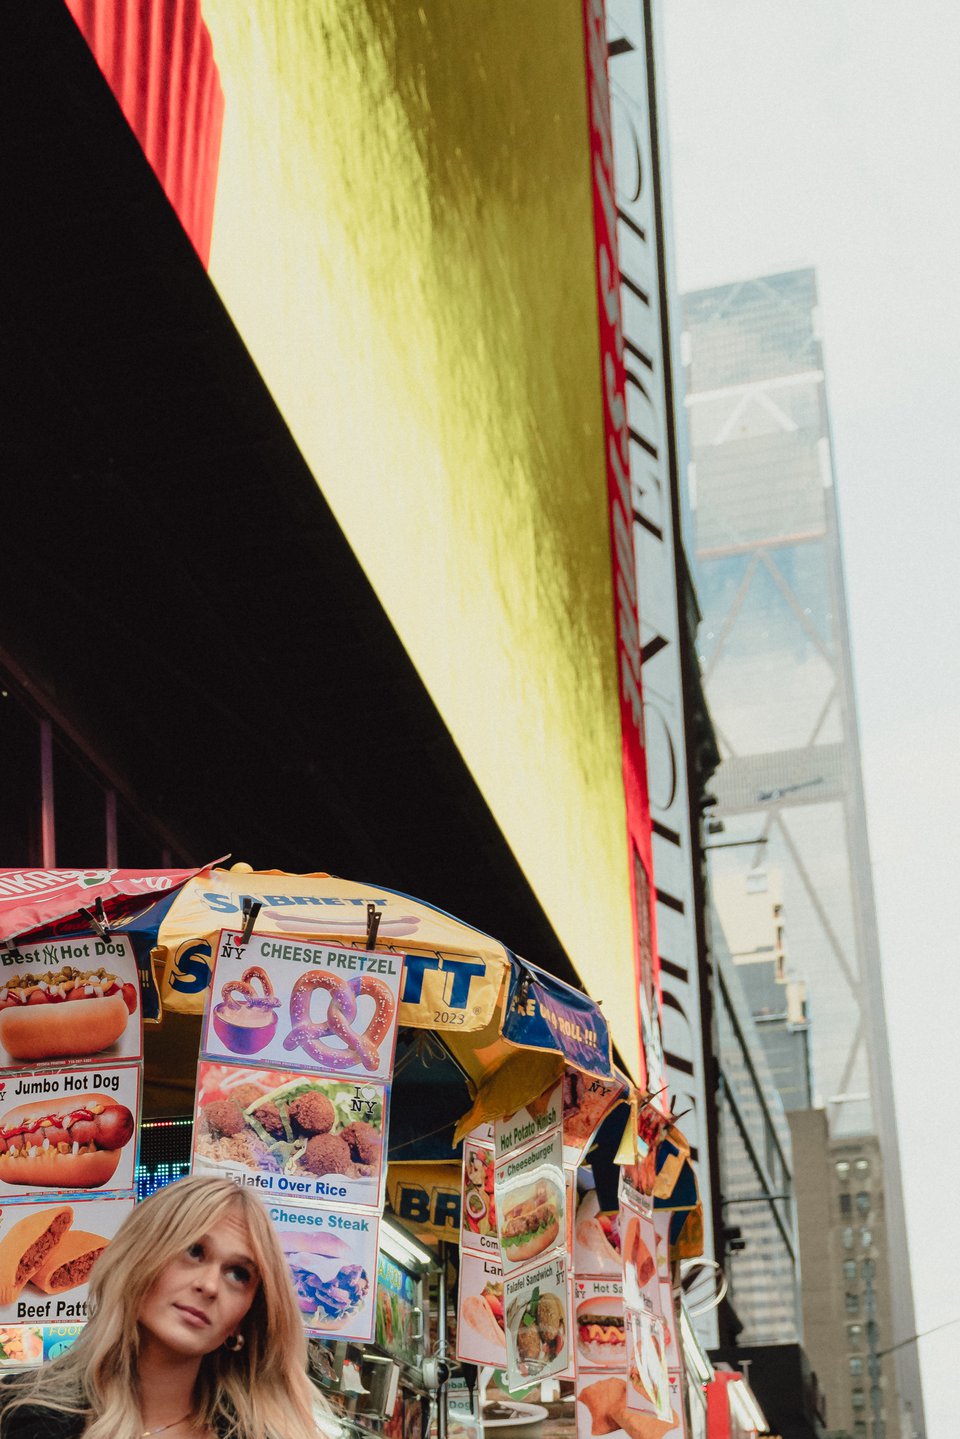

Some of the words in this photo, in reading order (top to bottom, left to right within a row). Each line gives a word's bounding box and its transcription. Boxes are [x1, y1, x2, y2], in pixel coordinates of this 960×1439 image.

[199, 892, 388, 914] SABRETT
[225, 933, 234, 946] I
[0, 949, 41, 967] Best
[60, 944, 90, 960] Hot
[94, 941, 126, 958] Dog
[220, 945, 247, 960] NY
[260, 942, 323, 965] CHEESE
[327, 951, 397, 976] PRETZEL
[433, 1011, 465, 1025] 2023
[558, 1017, 583, 1042] ROLL
[14, 1078, 59, 1096] Jumbo
[64, 1075, 88, 1091] Hot
[93, 1073, 120, 1092] Dog
[354, 1086, 361, 1099] I
[588, 1083, 611, 1097] NY
[350, 1099, 377, 1115] NY
[500, 1133, 513, 1151] Hot
[514, 1121, 536, 1142] Potato
[506, 1143, 555, 1177] Cheeseburger
[225, 1171, 274, 1189] Falafel
[277, 1178, 312, 1194] Over
[315, 1183, 348, 1197] Rice
[269, 1208, 324, 1227] Cheese
[327, 1214, 370, 1232] Steak
[506, 1276, 525, 1295] Falafel
[525, 1264, 553, 1287] Sandwich
[593, 1283, 610, 1295] Hot
[17, 1301, 51, 1318] Beef
